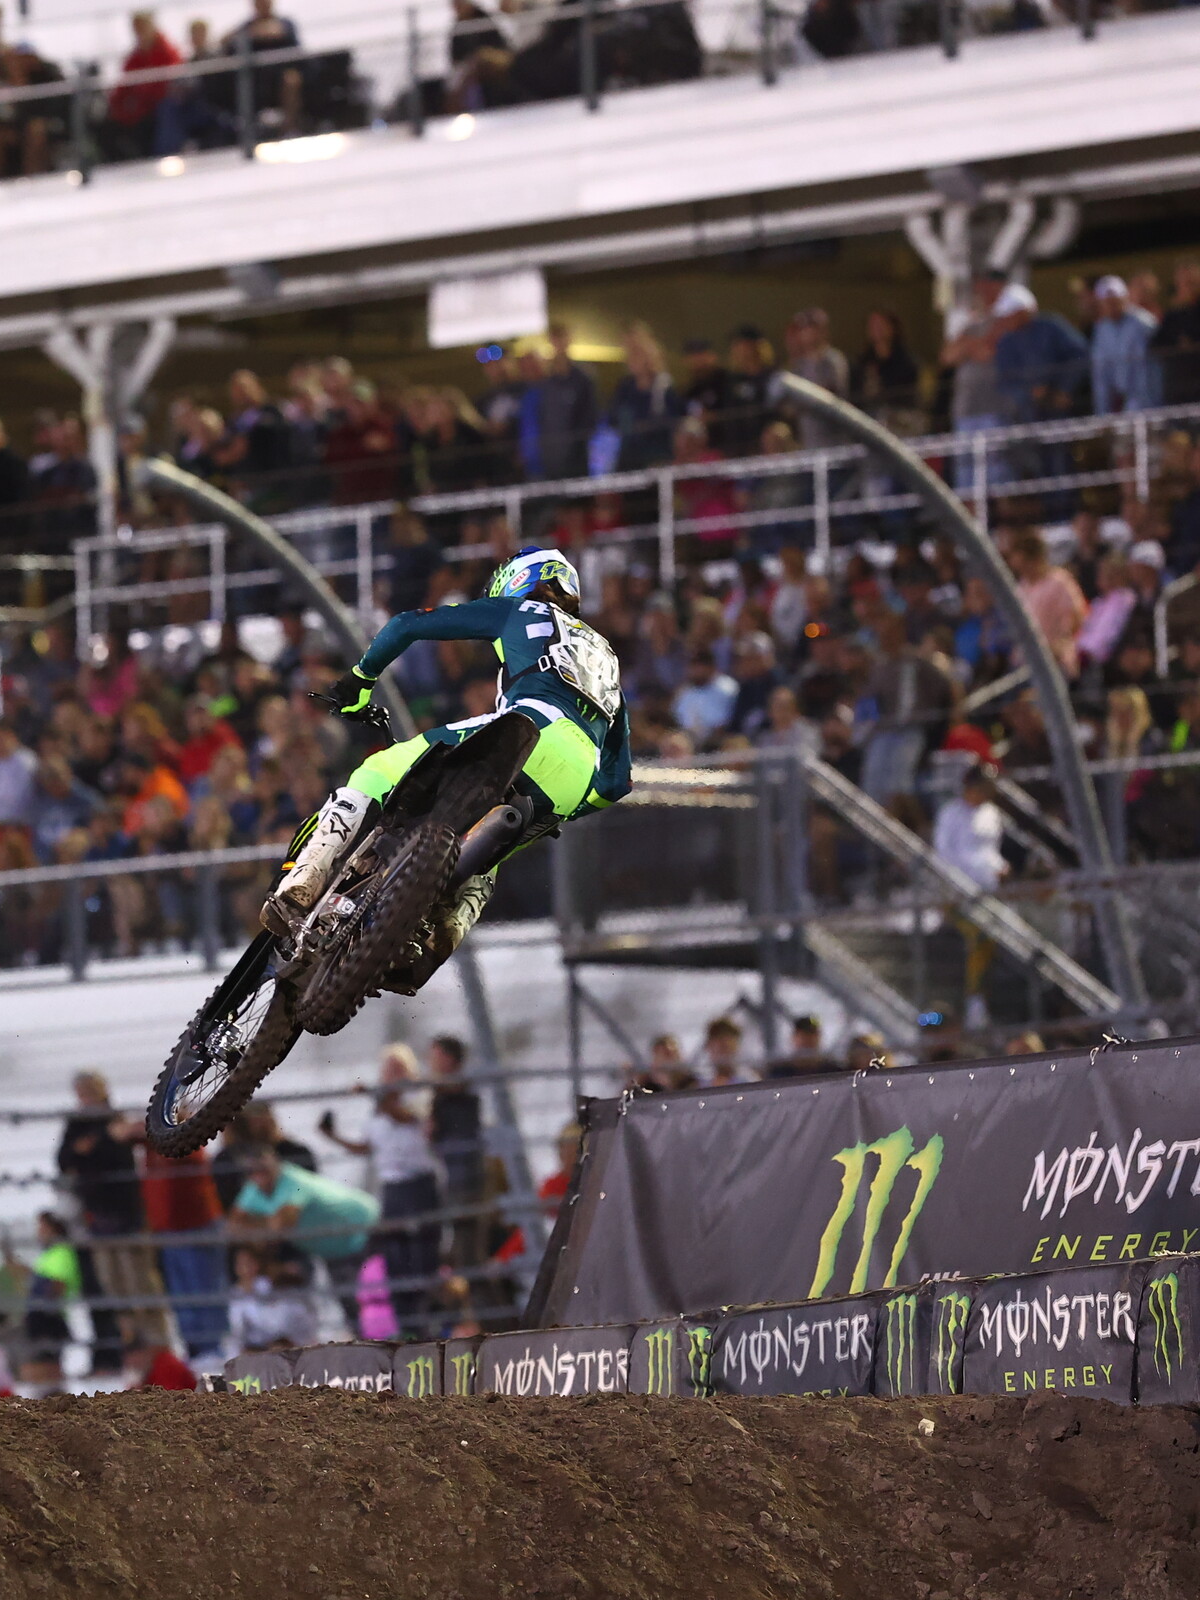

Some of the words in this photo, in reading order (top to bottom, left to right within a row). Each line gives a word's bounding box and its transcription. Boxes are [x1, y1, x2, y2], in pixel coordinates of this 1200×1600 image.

[1022, 1127, 1200, 1221] MONST
[1030, 1228, 1199, 1264] ENERGY
[1003, 1363, 1113, 1393] ENERGY
